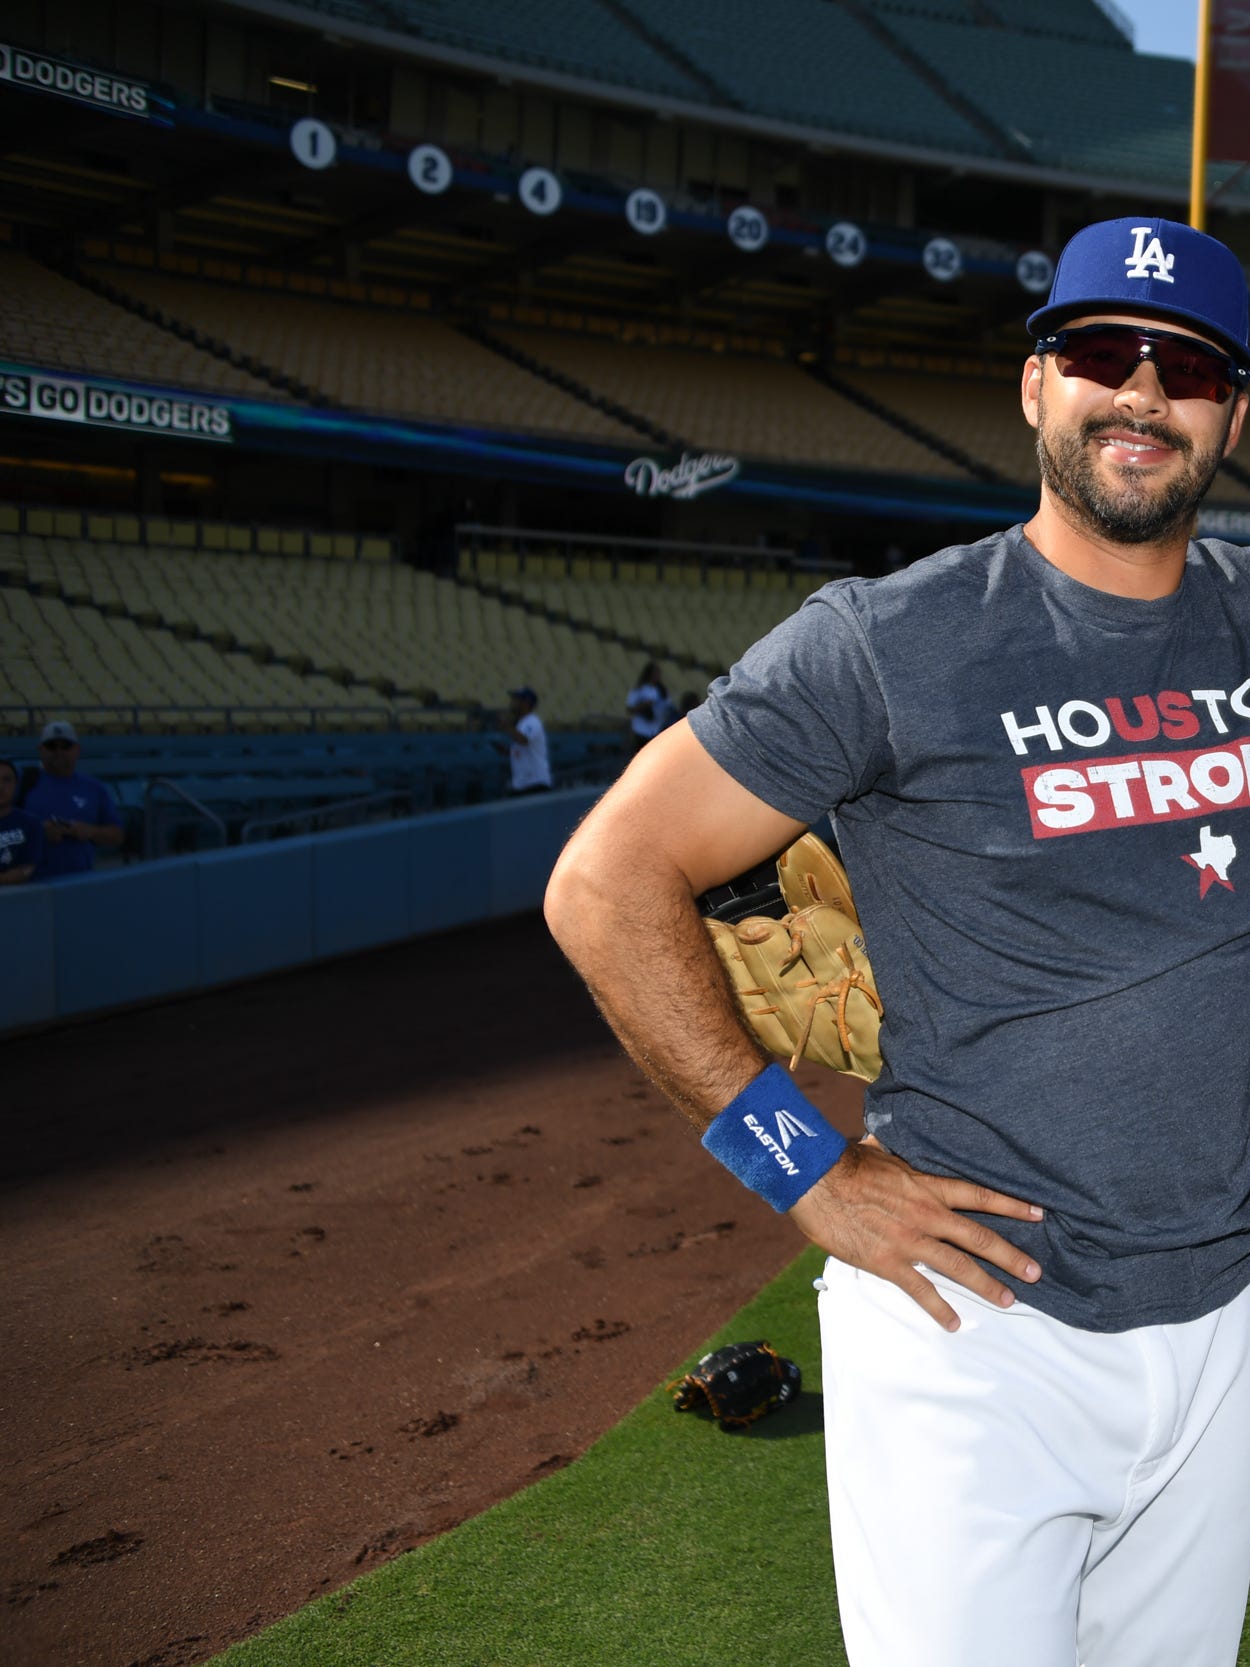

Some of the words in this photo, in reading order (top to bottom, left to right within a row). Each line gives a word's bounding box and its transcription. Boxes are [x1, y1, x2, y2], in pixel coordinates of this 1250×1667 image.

[15, 54, 148, 111] DODGERS
[308, 130, 320, 159] 1
[422, 156, 439, 184] 2
[531, 178, 547, 205] 4
[732, 214, 764, 242] 20
[831, 231, 861, 257] 24
[1124, 226, 1176, 284] LA
[37, 383, 80, 413] GO
[88, 390, 230, 436] DODGERS
[743, 1113, 800, 1176] EASTON
